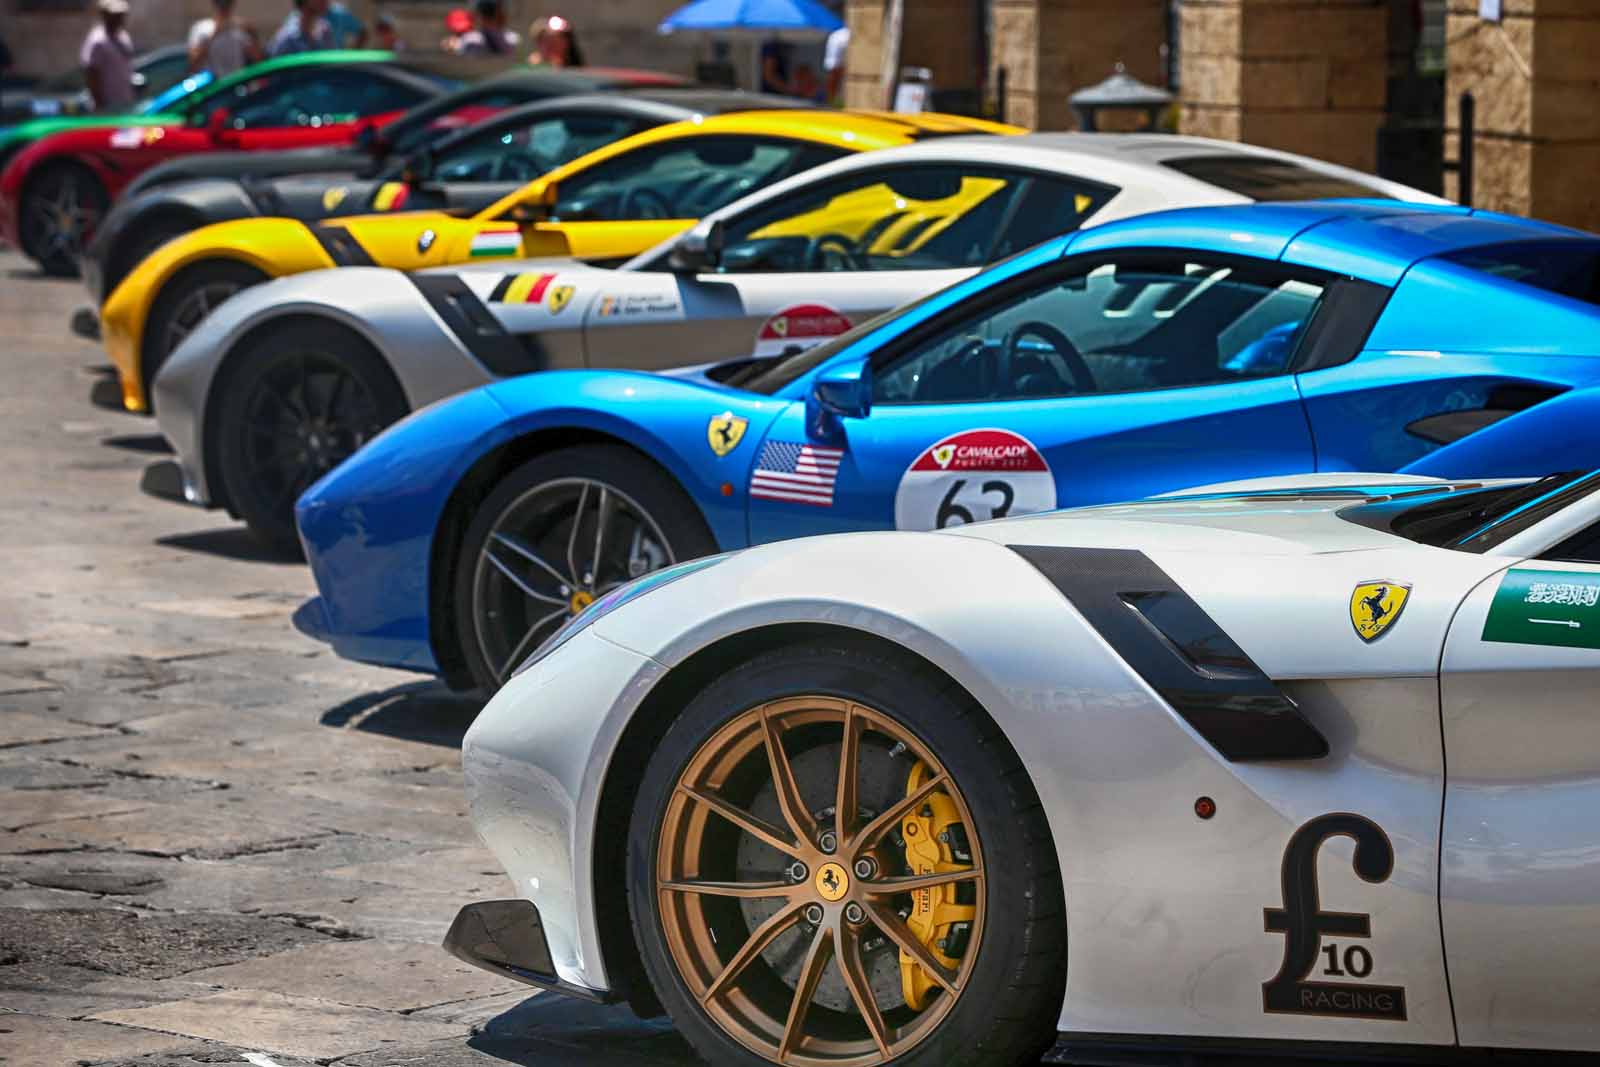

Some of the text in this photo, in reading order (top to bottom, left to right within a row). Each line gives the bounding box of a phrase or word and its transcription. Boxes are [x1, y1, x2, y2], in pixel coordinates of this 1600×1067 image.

[957, 445, 1028, 458] CAVALCADE
[1321, 943, 1374, 978] 10
[1300, 988, 1393, 1012] RACING
